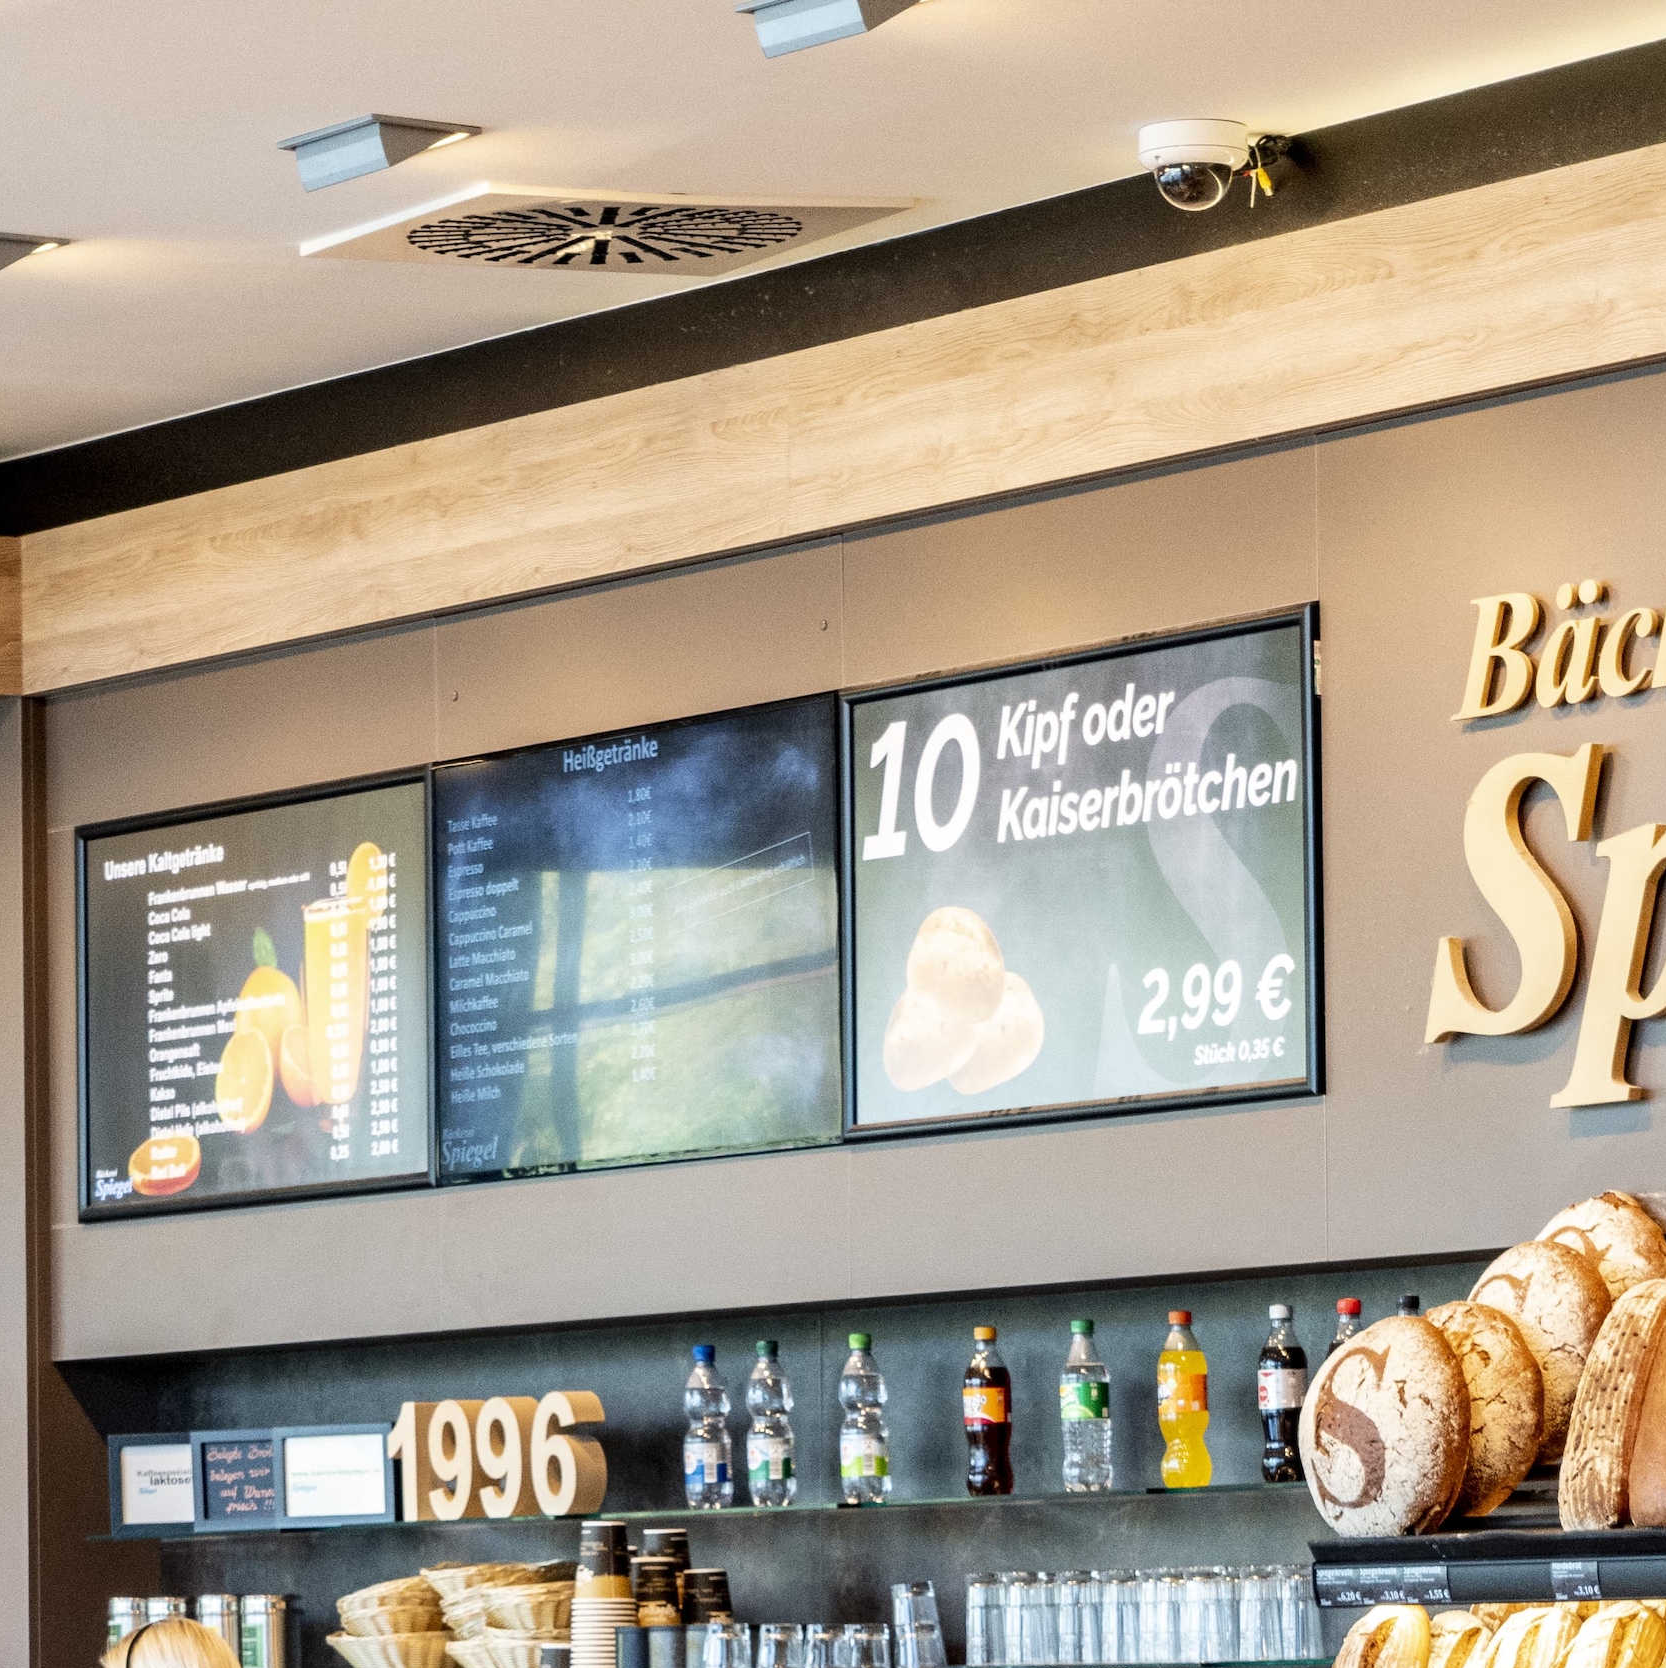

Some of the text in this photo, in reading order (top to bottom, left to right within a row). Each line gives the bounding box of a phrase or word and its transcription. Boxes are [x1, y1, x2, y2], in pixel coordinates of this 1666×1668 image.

[996, 683, 1176, 770] Kipf oder
[563, 734, 659, 774] Heißgetränke
[862, 712, 981, 862] 10
[997, 752, 1298, 843] Kaiserbrötchen
[104, 844, 224, 881] Unsere Kaltgetränke
[148, 950, 169, 965] Zero
[148, 969, 173, 984] Fanta
[1137, 952, 1295, 1042] 2,99 €
[442, 1135, 499, 1171] Spiegel
[95, 1176, 133, 1200] Spiegel
[388, 1390, 608, 1522] 1996
